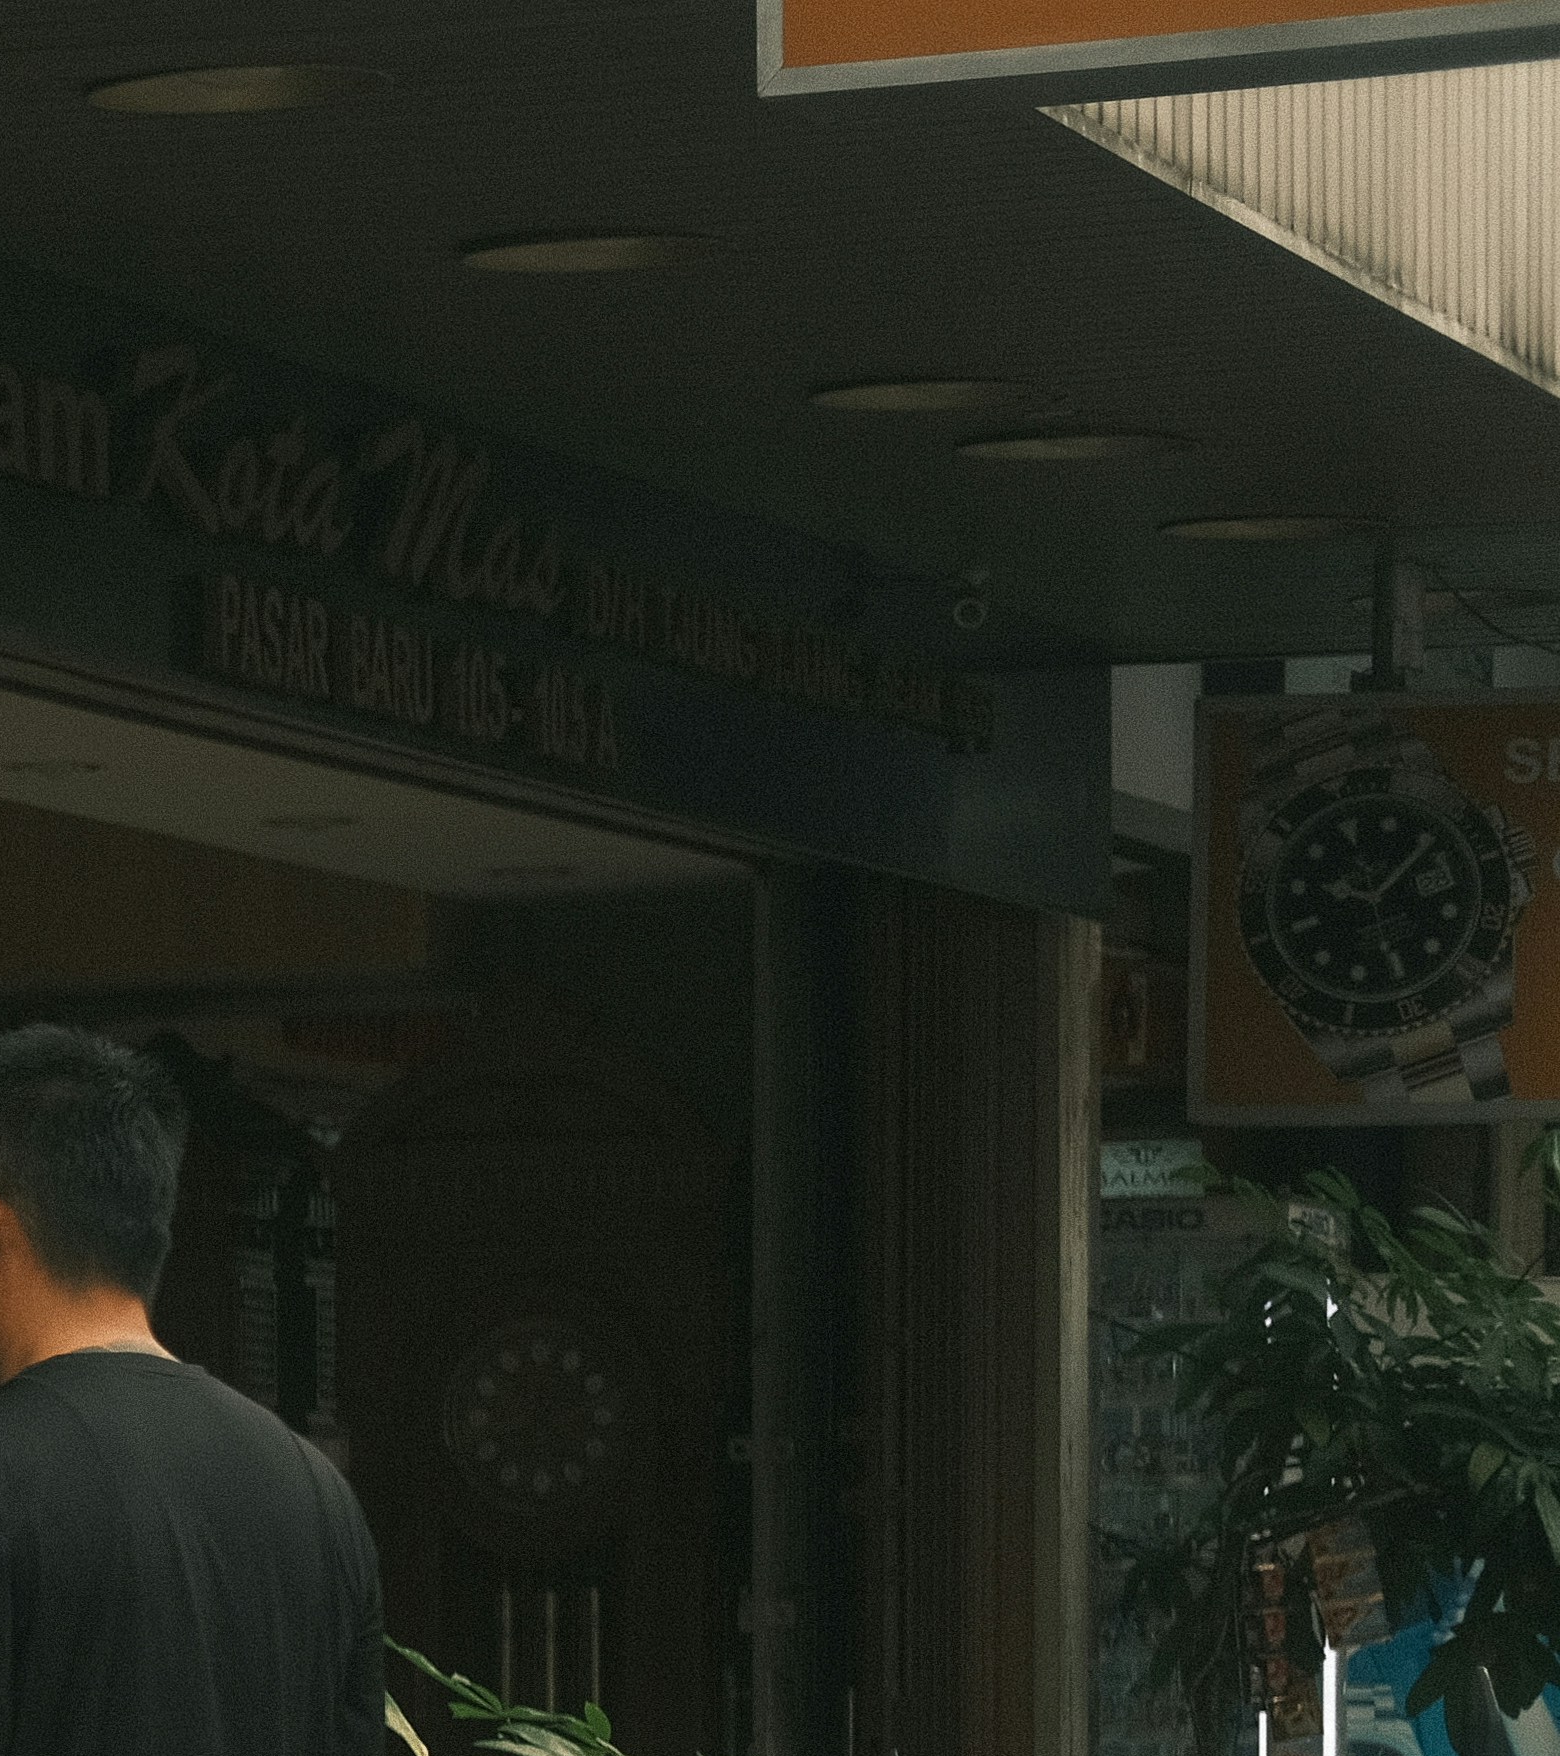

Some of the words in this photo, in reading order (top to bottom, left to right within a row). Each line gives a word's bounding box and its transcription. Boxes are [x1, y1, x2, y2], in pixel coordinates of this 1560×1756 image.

[133, 341, 351, 556] Kota
[367, 416, 567, 614] Mas
[216, 571, 330, 700] PASAR
[349, 612, 435, 726] BARU
